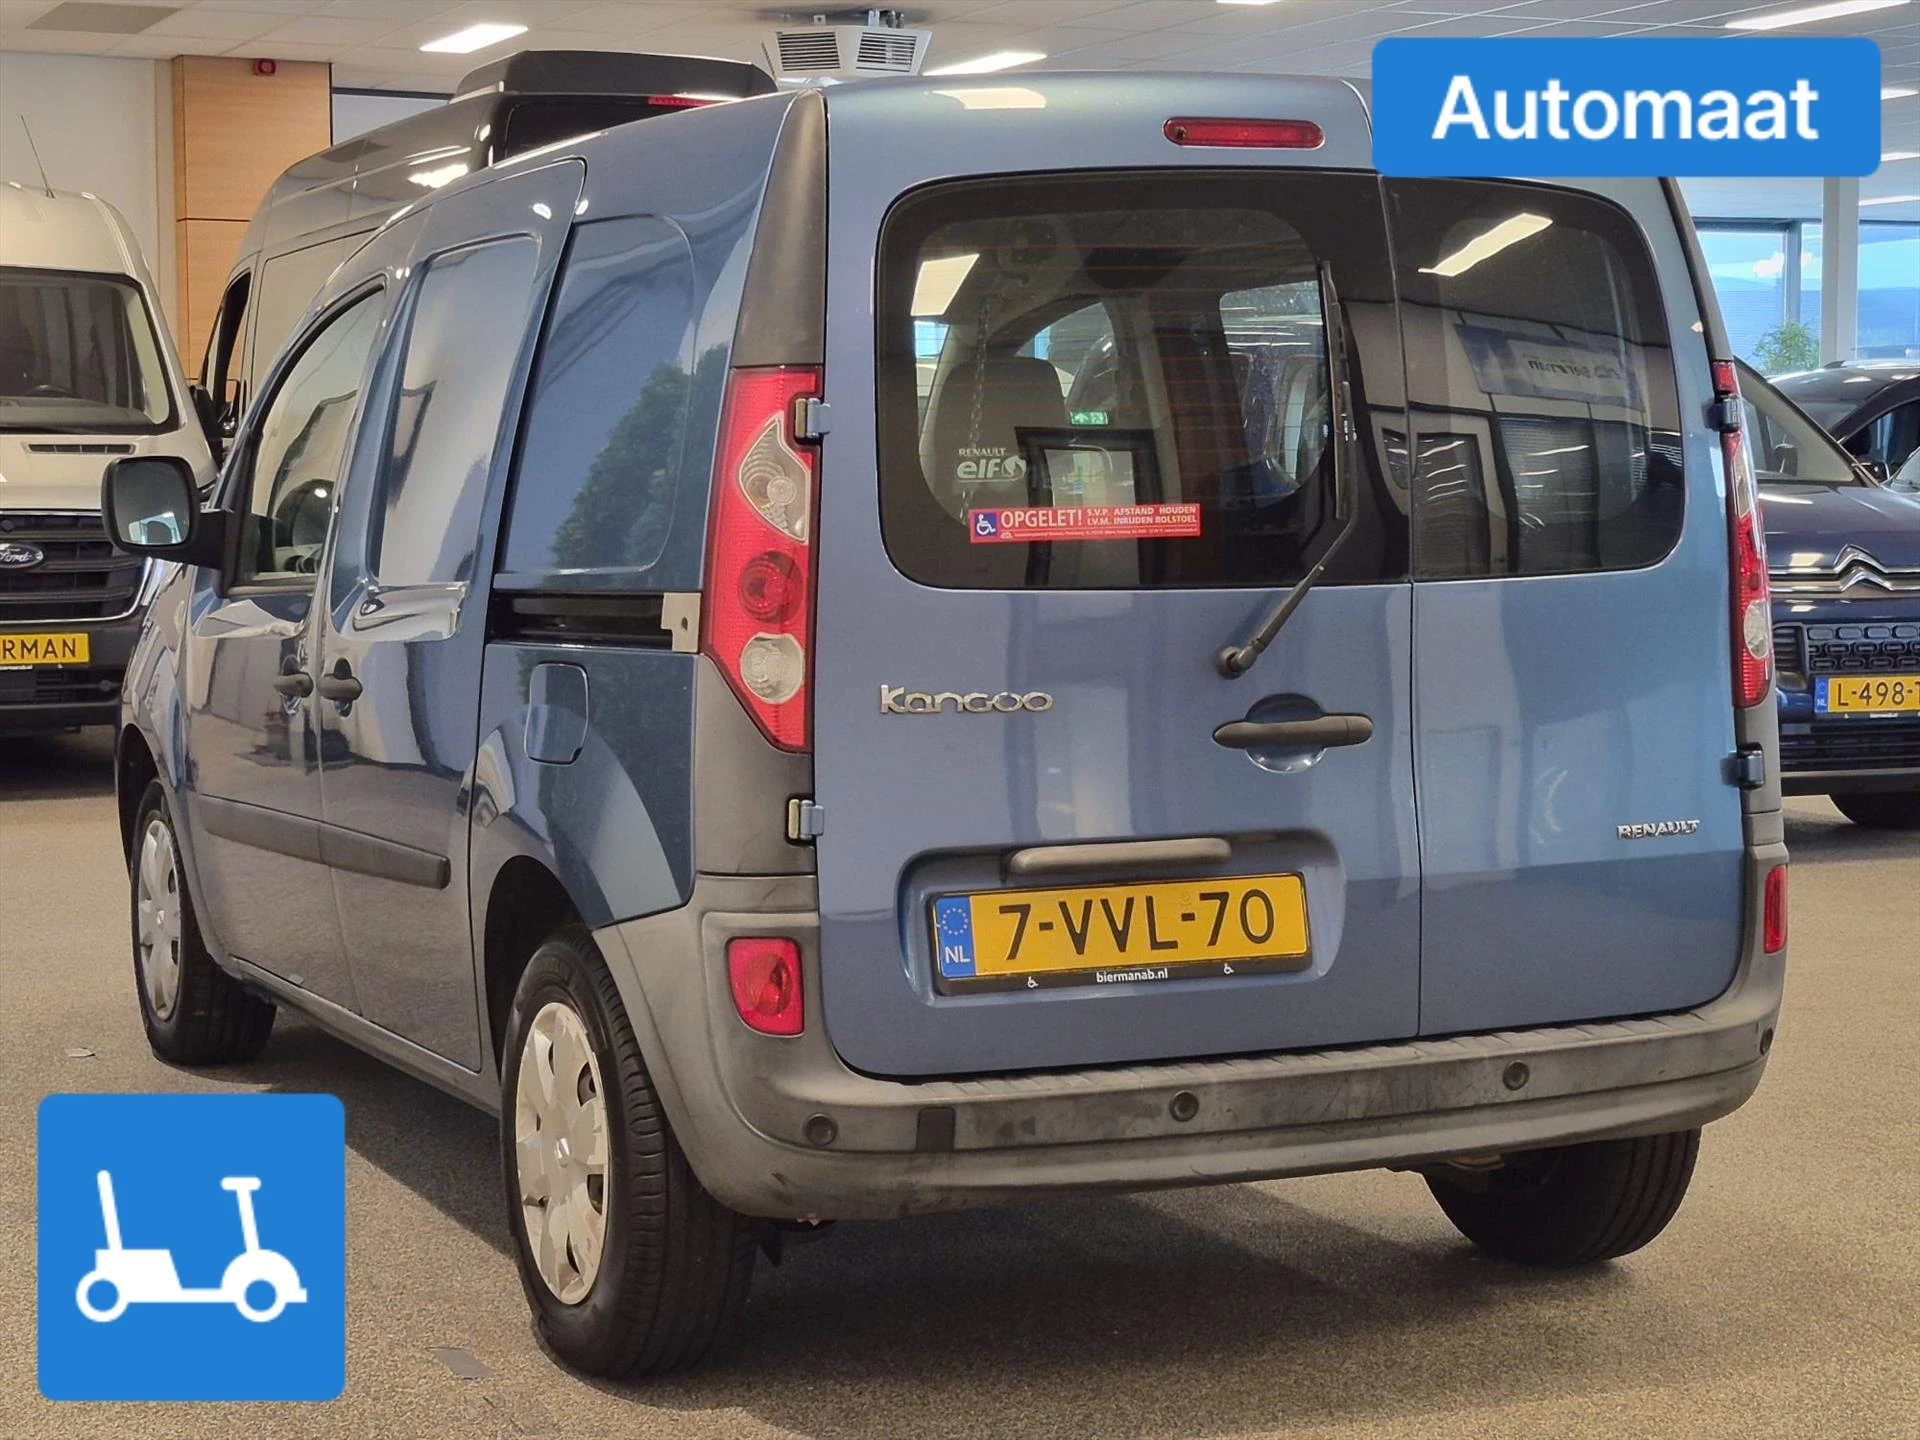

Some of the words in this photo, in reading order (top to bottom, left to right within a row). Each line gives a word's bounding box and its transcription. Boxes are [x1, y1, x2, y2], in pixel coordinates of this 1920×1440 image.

[958, 447, 1006, 457] RENAULT
[957, 457, 1001, 478] elf
[1001, 508, 1083, 528] OPGELET!
[1086, 508, 1109, 517] S.V.P.
[1114, 507, 1154, 516] AFSTAND
[1159, 506, 1197, 515] HOUDEN
[1087, 517, 1111, 526] I.V.M.
[1114, 515, 1154, 525] INRIJDEN
[1155, 514, 1197, 524] ROLSTOEL
[2, 638, 77, 660] RMAN
[880, 684, 1053, 713] Kangoo
[1816, 698, 1827, 707] NL
[1617, 819, 1700, 839] RENAULT
[944, 945, 970, 964] NL
[999, 888, 1275, 961] 7-VVL-70
[1096, 967, 1169, 984] biermanab.nl
